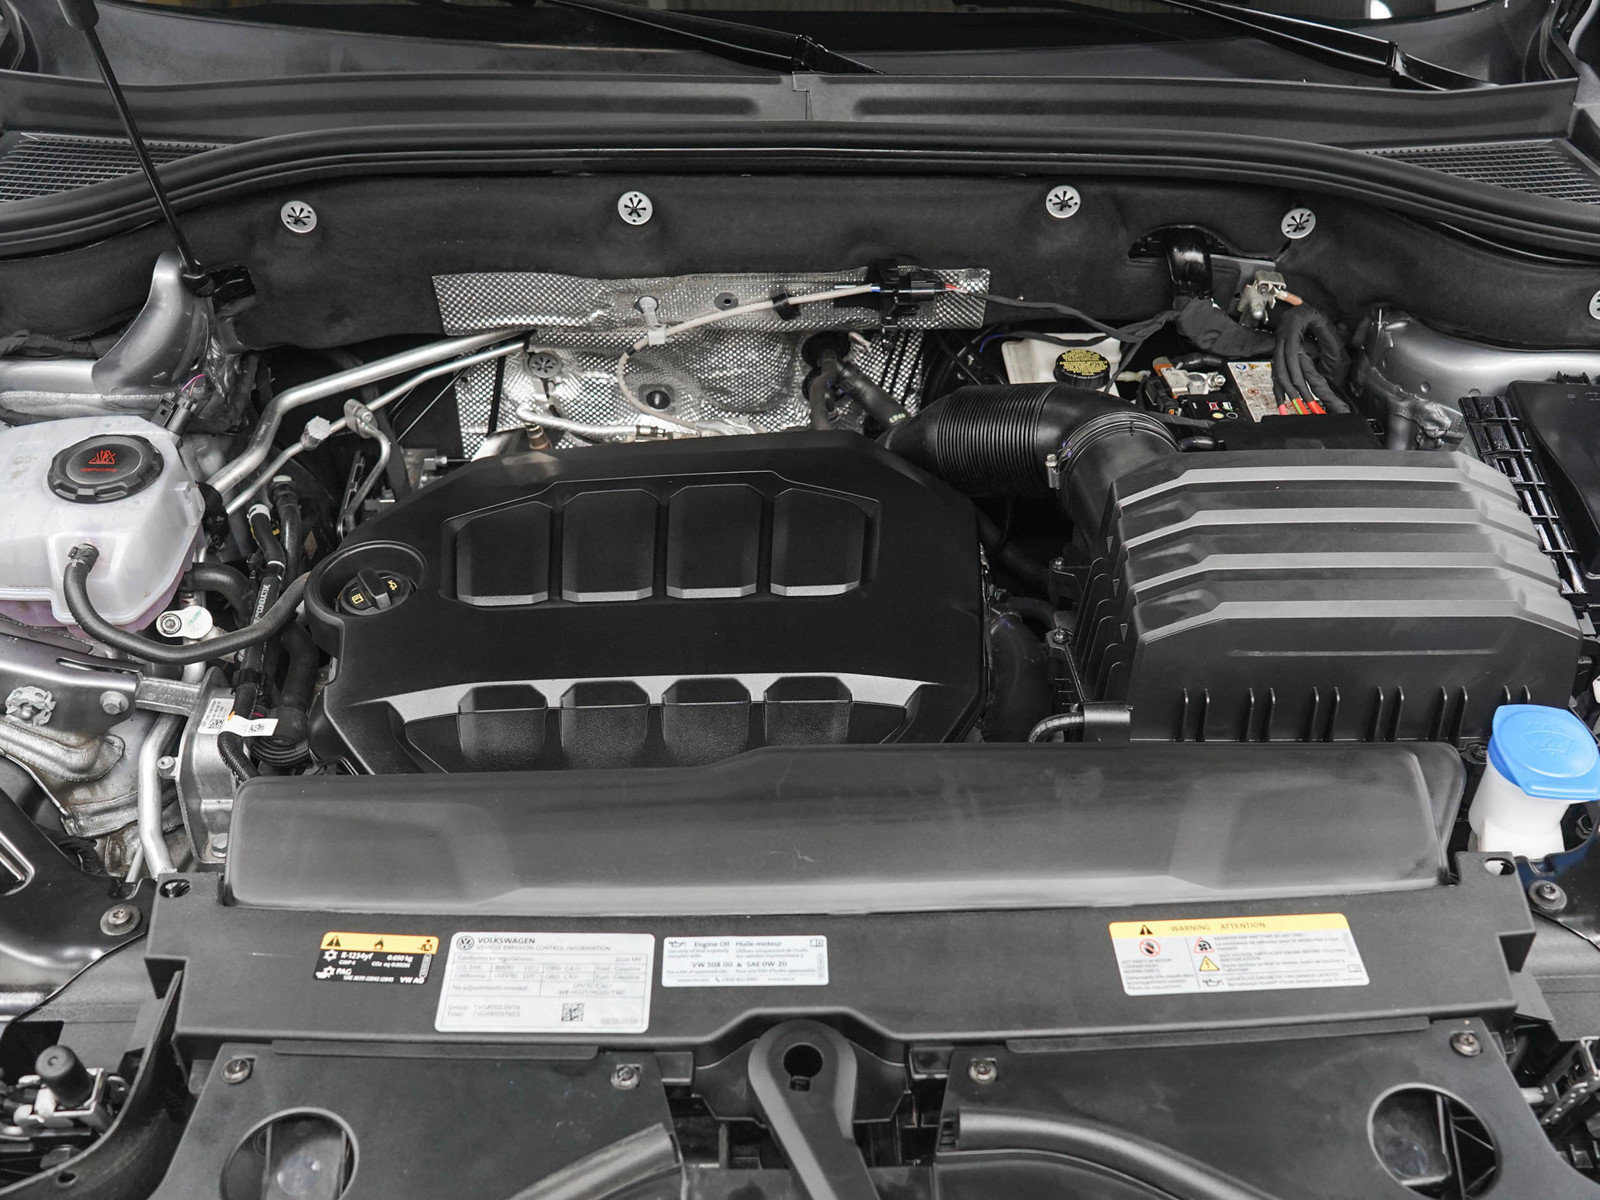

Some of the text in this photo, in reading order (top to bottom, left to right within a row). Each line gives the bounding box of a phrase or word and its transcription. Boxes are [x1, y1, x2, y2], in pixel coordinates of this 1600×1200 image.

[1169, 922, 1266, 932] WARNING ATTENTION
[478, 937, 536, 945] VOLKSWAGEN
[694, 941, 718, 949] Engine
[341, 951, 374, 962] R-1234yf
[404, 955, 413, 963] kg
[335, 968, 352, 976] PAG
[399, 976, 425, 984] VW AG
